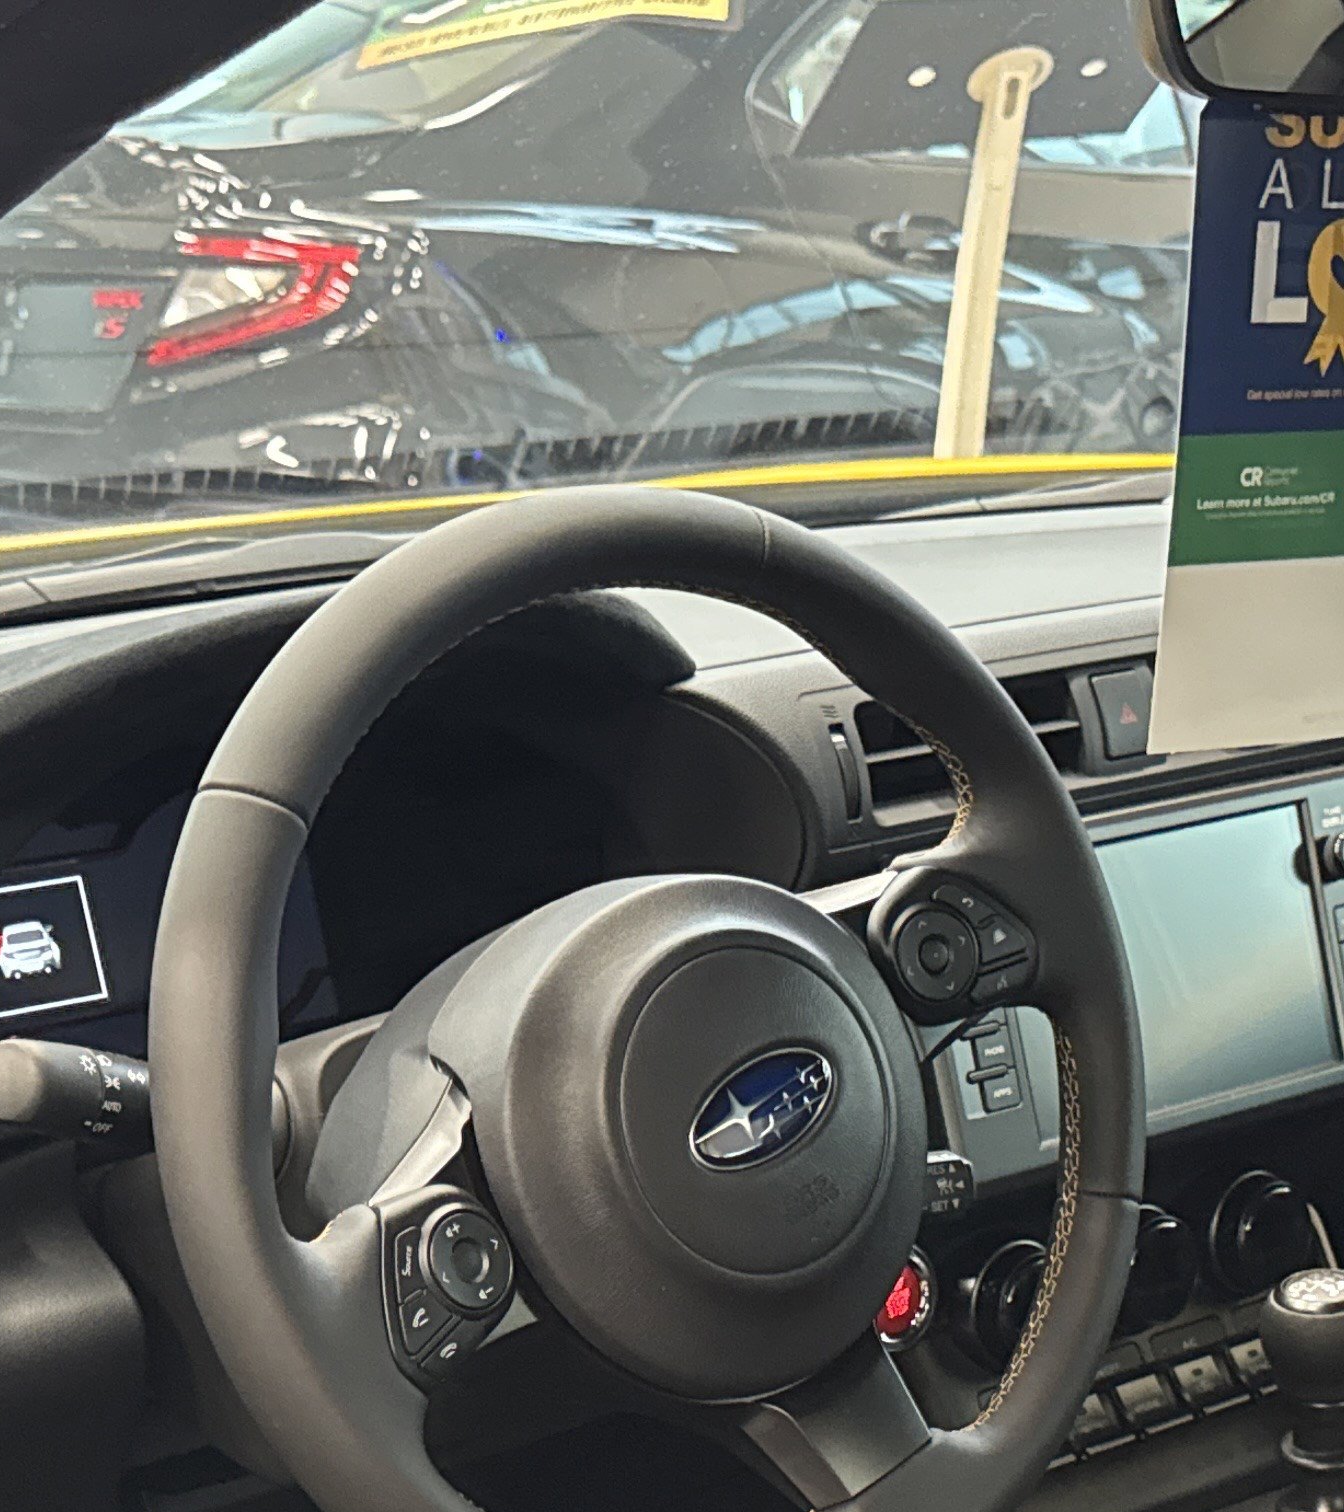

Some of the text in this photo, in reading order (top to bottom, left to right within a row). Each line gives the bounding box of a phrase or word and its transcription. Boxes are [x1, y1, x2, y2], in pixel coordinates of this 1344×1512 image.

[1258, 157, 1294, 210] A
[1239, 466, 1264, 488] CR
[1196, 498, 1224, 511] Learn
[1225, 498, 1251, 509] more
[1252, 496, 1263, 508] at
